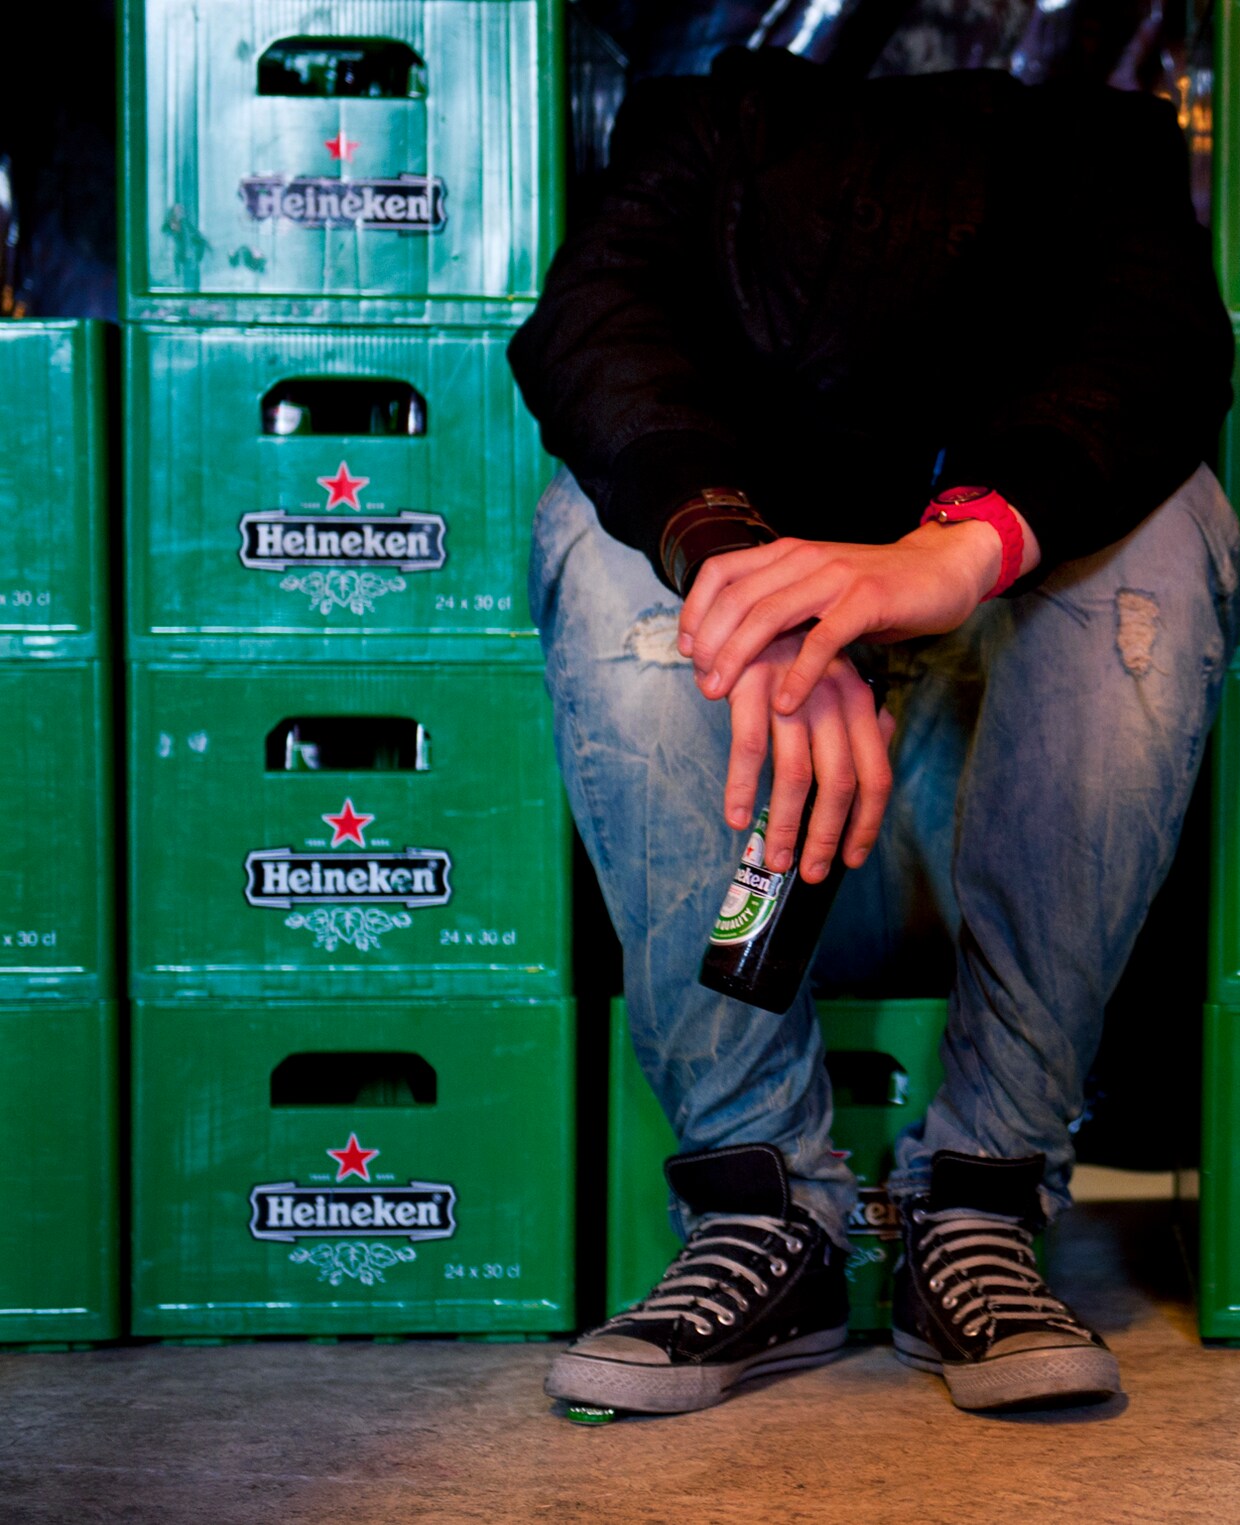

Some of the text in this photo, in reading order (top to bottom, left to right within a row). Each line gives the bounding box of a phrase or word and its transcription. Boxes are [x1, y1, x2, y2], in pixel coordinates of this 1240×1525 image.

[257, 186, 431, 221] Heineken
[256, 523, 431, 558] Heineken
[12, 589, 33, 607] 30
[435, 595, 454, 611] 24
[459, 598, 469, 610] x
[474, 595, 494, 611] 30
[261, 860, 438, 895] Heineken
[719, 907, 754, 931] QUALITY
[16, 930, 38, 947] 30
[440, 929, 459, 945] 24
[464, 933, 474, 945] x
[478, 929, 498, 945] 30
[266, 1195, 442, 1228] Heineken
[444, 1264, 464, 1279] 24
[469, 1268, 478, 1279] x
[483, 1264, 503, 1279] 30
